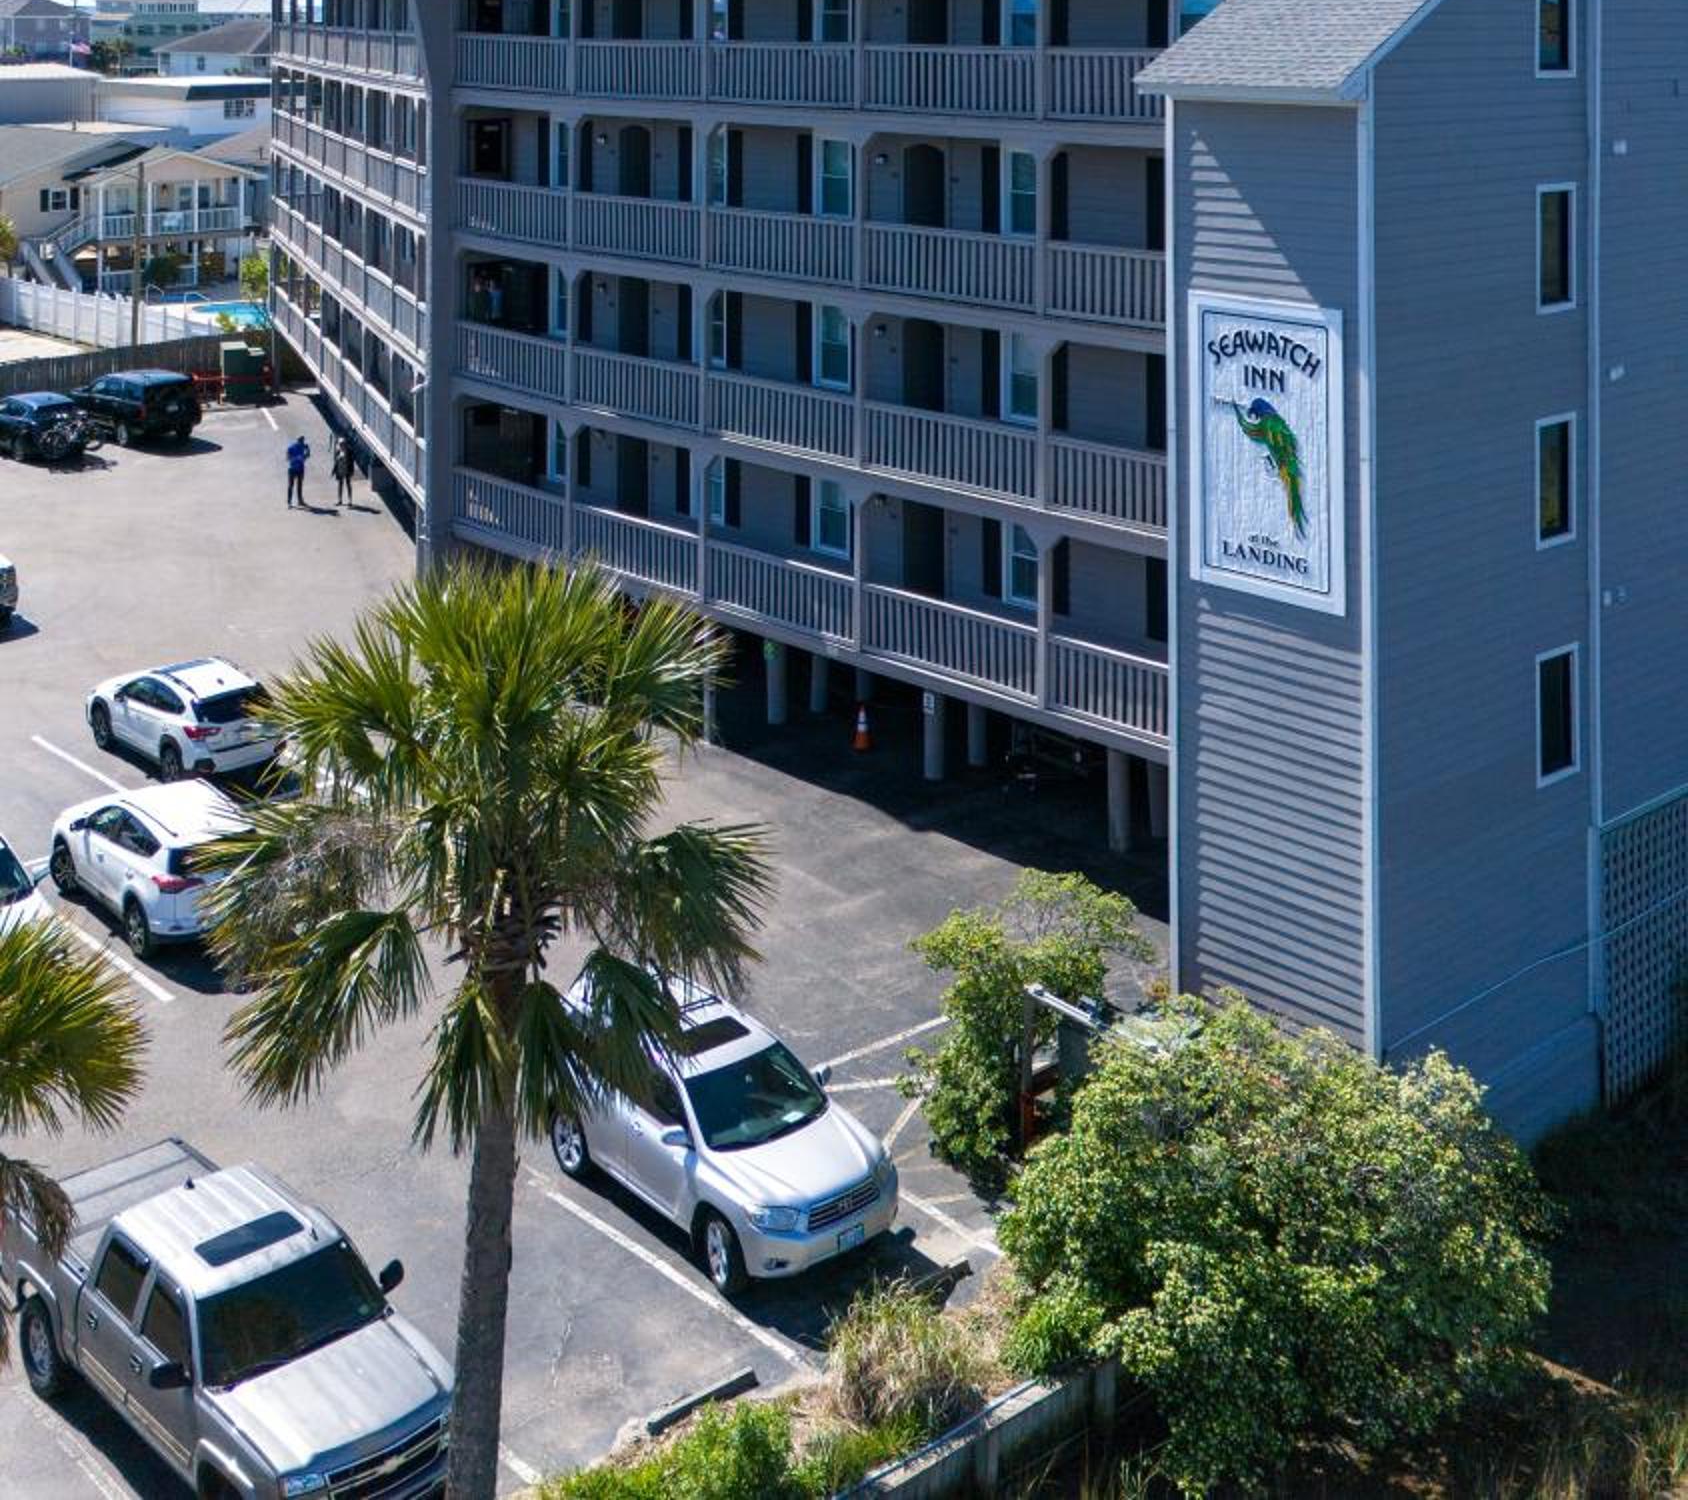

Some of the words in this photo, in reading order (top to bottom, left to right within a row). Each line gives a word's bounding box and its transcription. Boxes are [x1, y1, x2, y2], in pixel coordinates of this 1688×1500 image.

[1207, 329, 1321, 379] SEAWATCH
[1244, 365, 1285, 393] INN
[1261, 534, 1279, 547] the
[1223, 540, 1309, 575] LANDING
